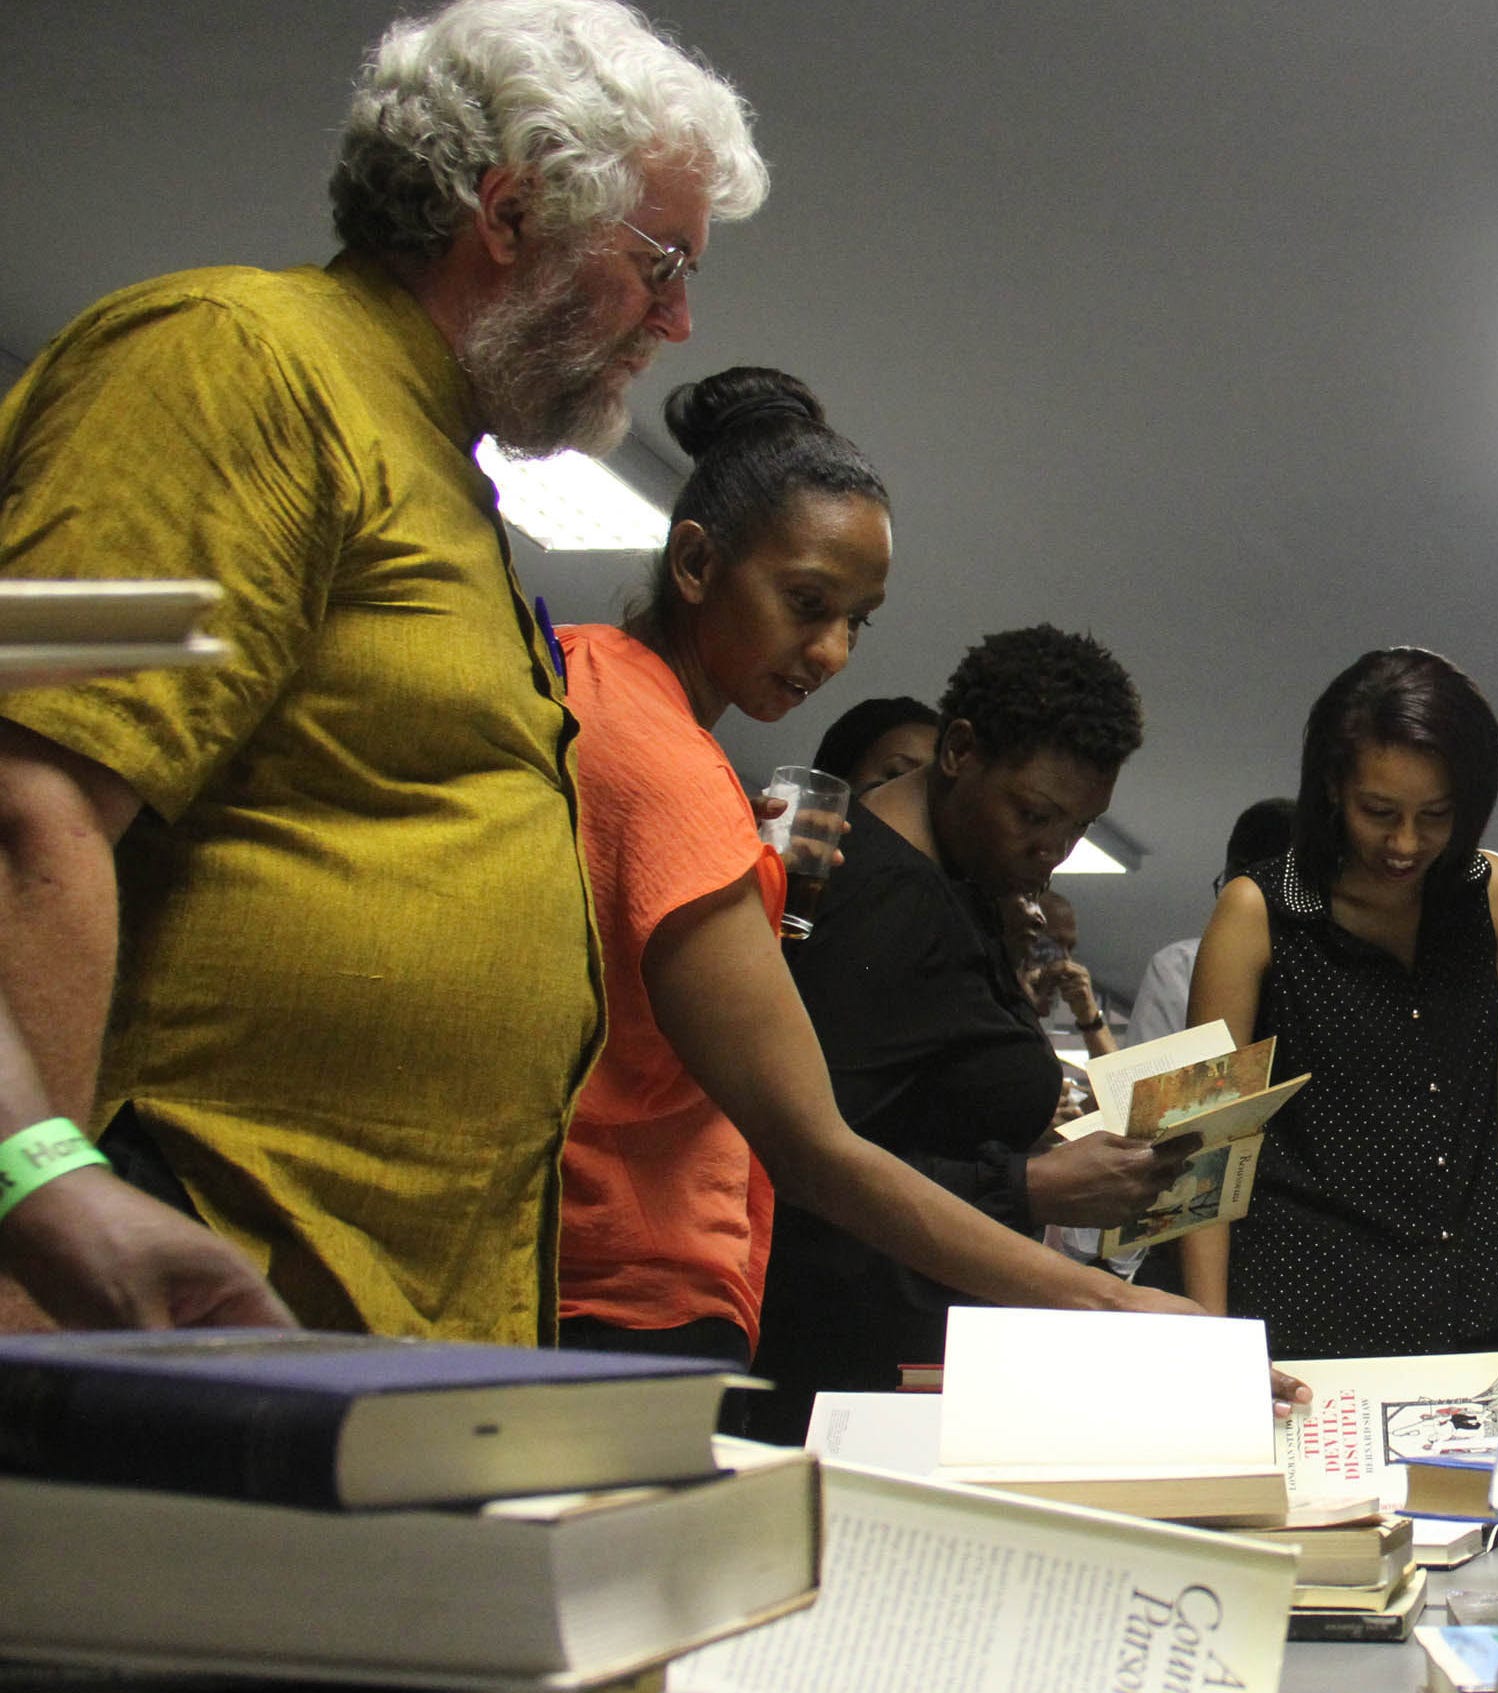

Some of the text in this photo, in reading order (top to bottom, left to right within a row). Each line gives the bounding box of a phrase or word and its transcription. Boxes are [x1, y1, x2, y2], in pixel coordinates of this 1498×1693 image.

[1286, 1449, 1297, 1491] LONGMAN
[1303, 1416, 1320, 1459] THE
[1322, 1399, 1341, 1473] DEVIL'S
[1340, 1389, 1361, 1480] DISCIPLE
[1361, 1398, 1374, 1474] BERNARD SHAW
[1111, 1586, 1175, 1693] Parso
[1202, 1649, 1247, 1689] A
